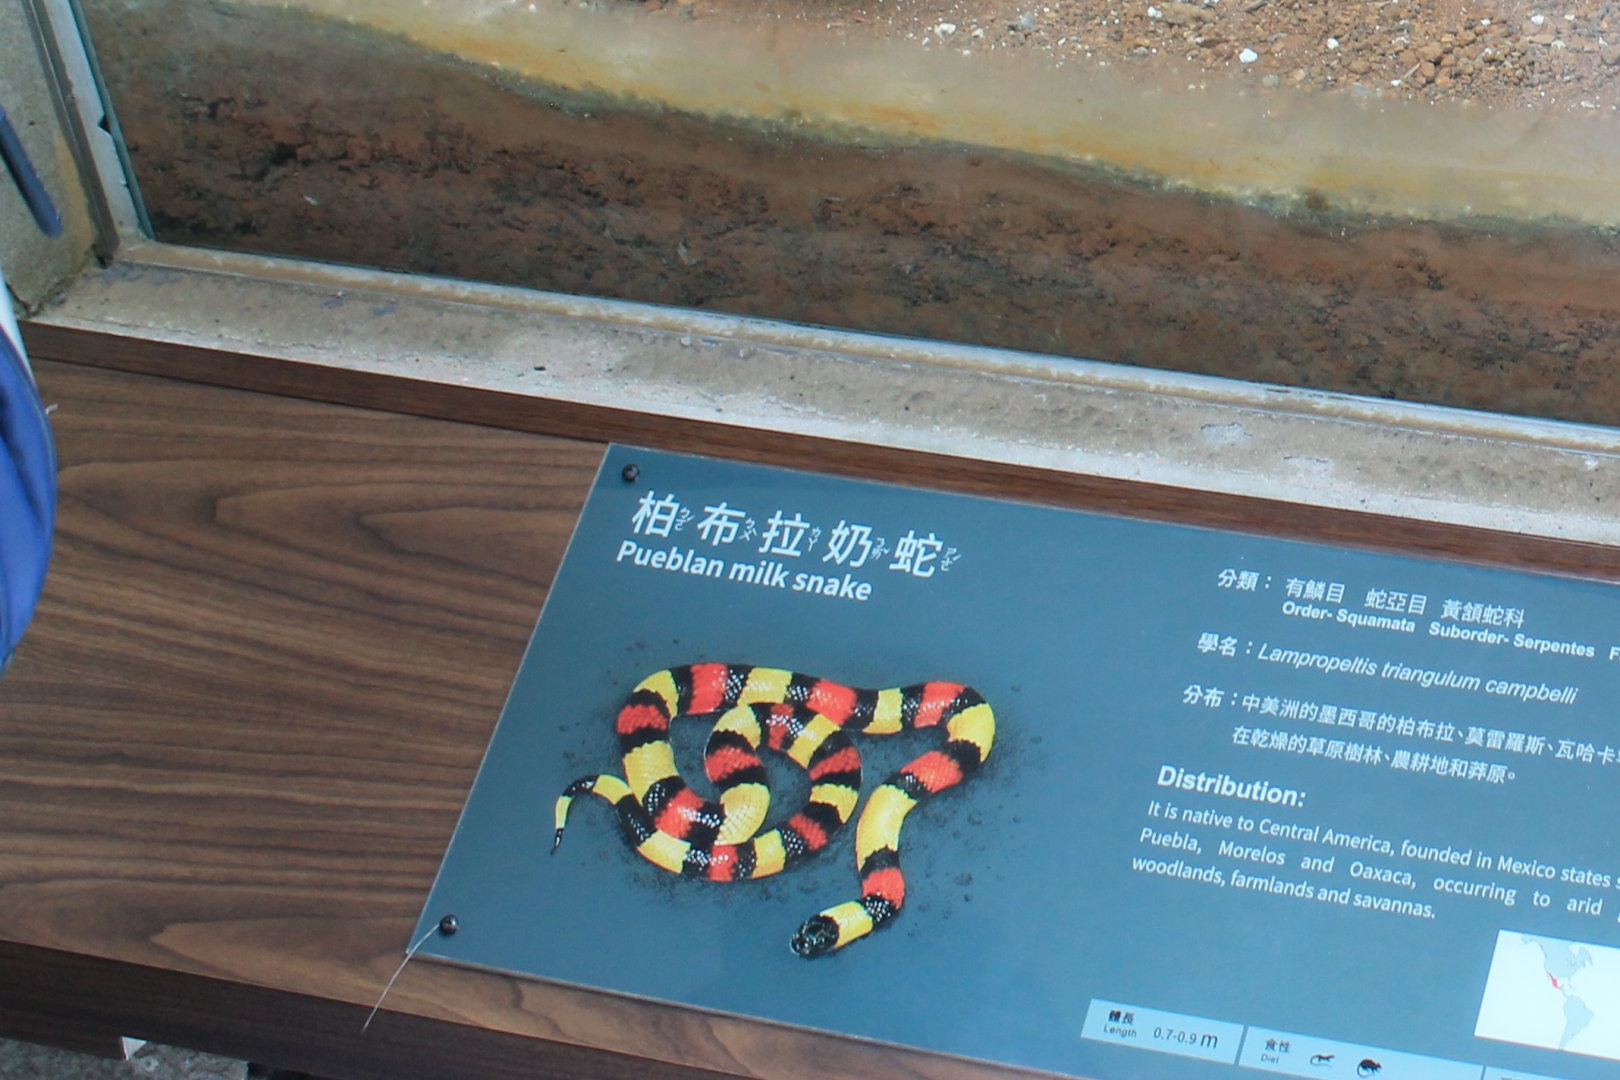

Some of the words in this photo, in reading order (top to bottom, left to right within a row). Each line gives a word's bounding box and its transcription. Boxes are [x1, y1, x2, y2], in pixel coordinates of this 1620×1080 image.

[631, 490, 945, 579] 柏布拉奶蛇
[616, 540, 725, 578] Pueblan
[728, 560, 790, 589] milk
[791, 572, 872, 601] snake
[1364, 587, 1427, 616] 蛇亞目
[1336, 608, 1416, 633] Squamata
[1513, 633, 1595, 658] Serpentes
[1257, 642, 1378, 676] Lampropeltis
[1381, 661, 1481, 691] triangulum
[1485, 679, 1579, 705] campbelli
[1157, 765, 1306, 808] Distribution:
[1148, 800, 1161, 817] It
[1164, 802, 1178, 820] is
[1182, 809, 1233, 829] native
[1237, 815, 1255, 832] to
[1259, 818, 1320, 843] Central
[1321, 828, 1395, 857] America,
[1400, 839, 1473, 866] founded
[1476, 851, 1492, 870] in
[1497, 855, 1556, 880] Mexico
[1560, 866, 1612, 888] states
[1132, 857, 1226, 888] woodlands,
[1230, 869, 1315, 899] farmlands
[1317, 887, 1351, 905] and
[1352, 893, 1436, 919] savannas.
[1139, 827, 1202, 855] Puebla,
[1218, 839, 1286, 866] Morelos
[1300, 856, 1335, 873] and
[1349, 861, 1416, 890] Oaxaca,
[1433, 877, 1517, 907] occurring
[1533, 890, 1551, 908] to
[1566, 897, 1603, 916] arid
[1103, 1023, 1138, 1038] Length
[1153, 1026, 1197, 1045] 0.7-0.9
[1264, 1037, 1291, 1053] 食性
[1260, 1052, 1280, 1064] Diet
